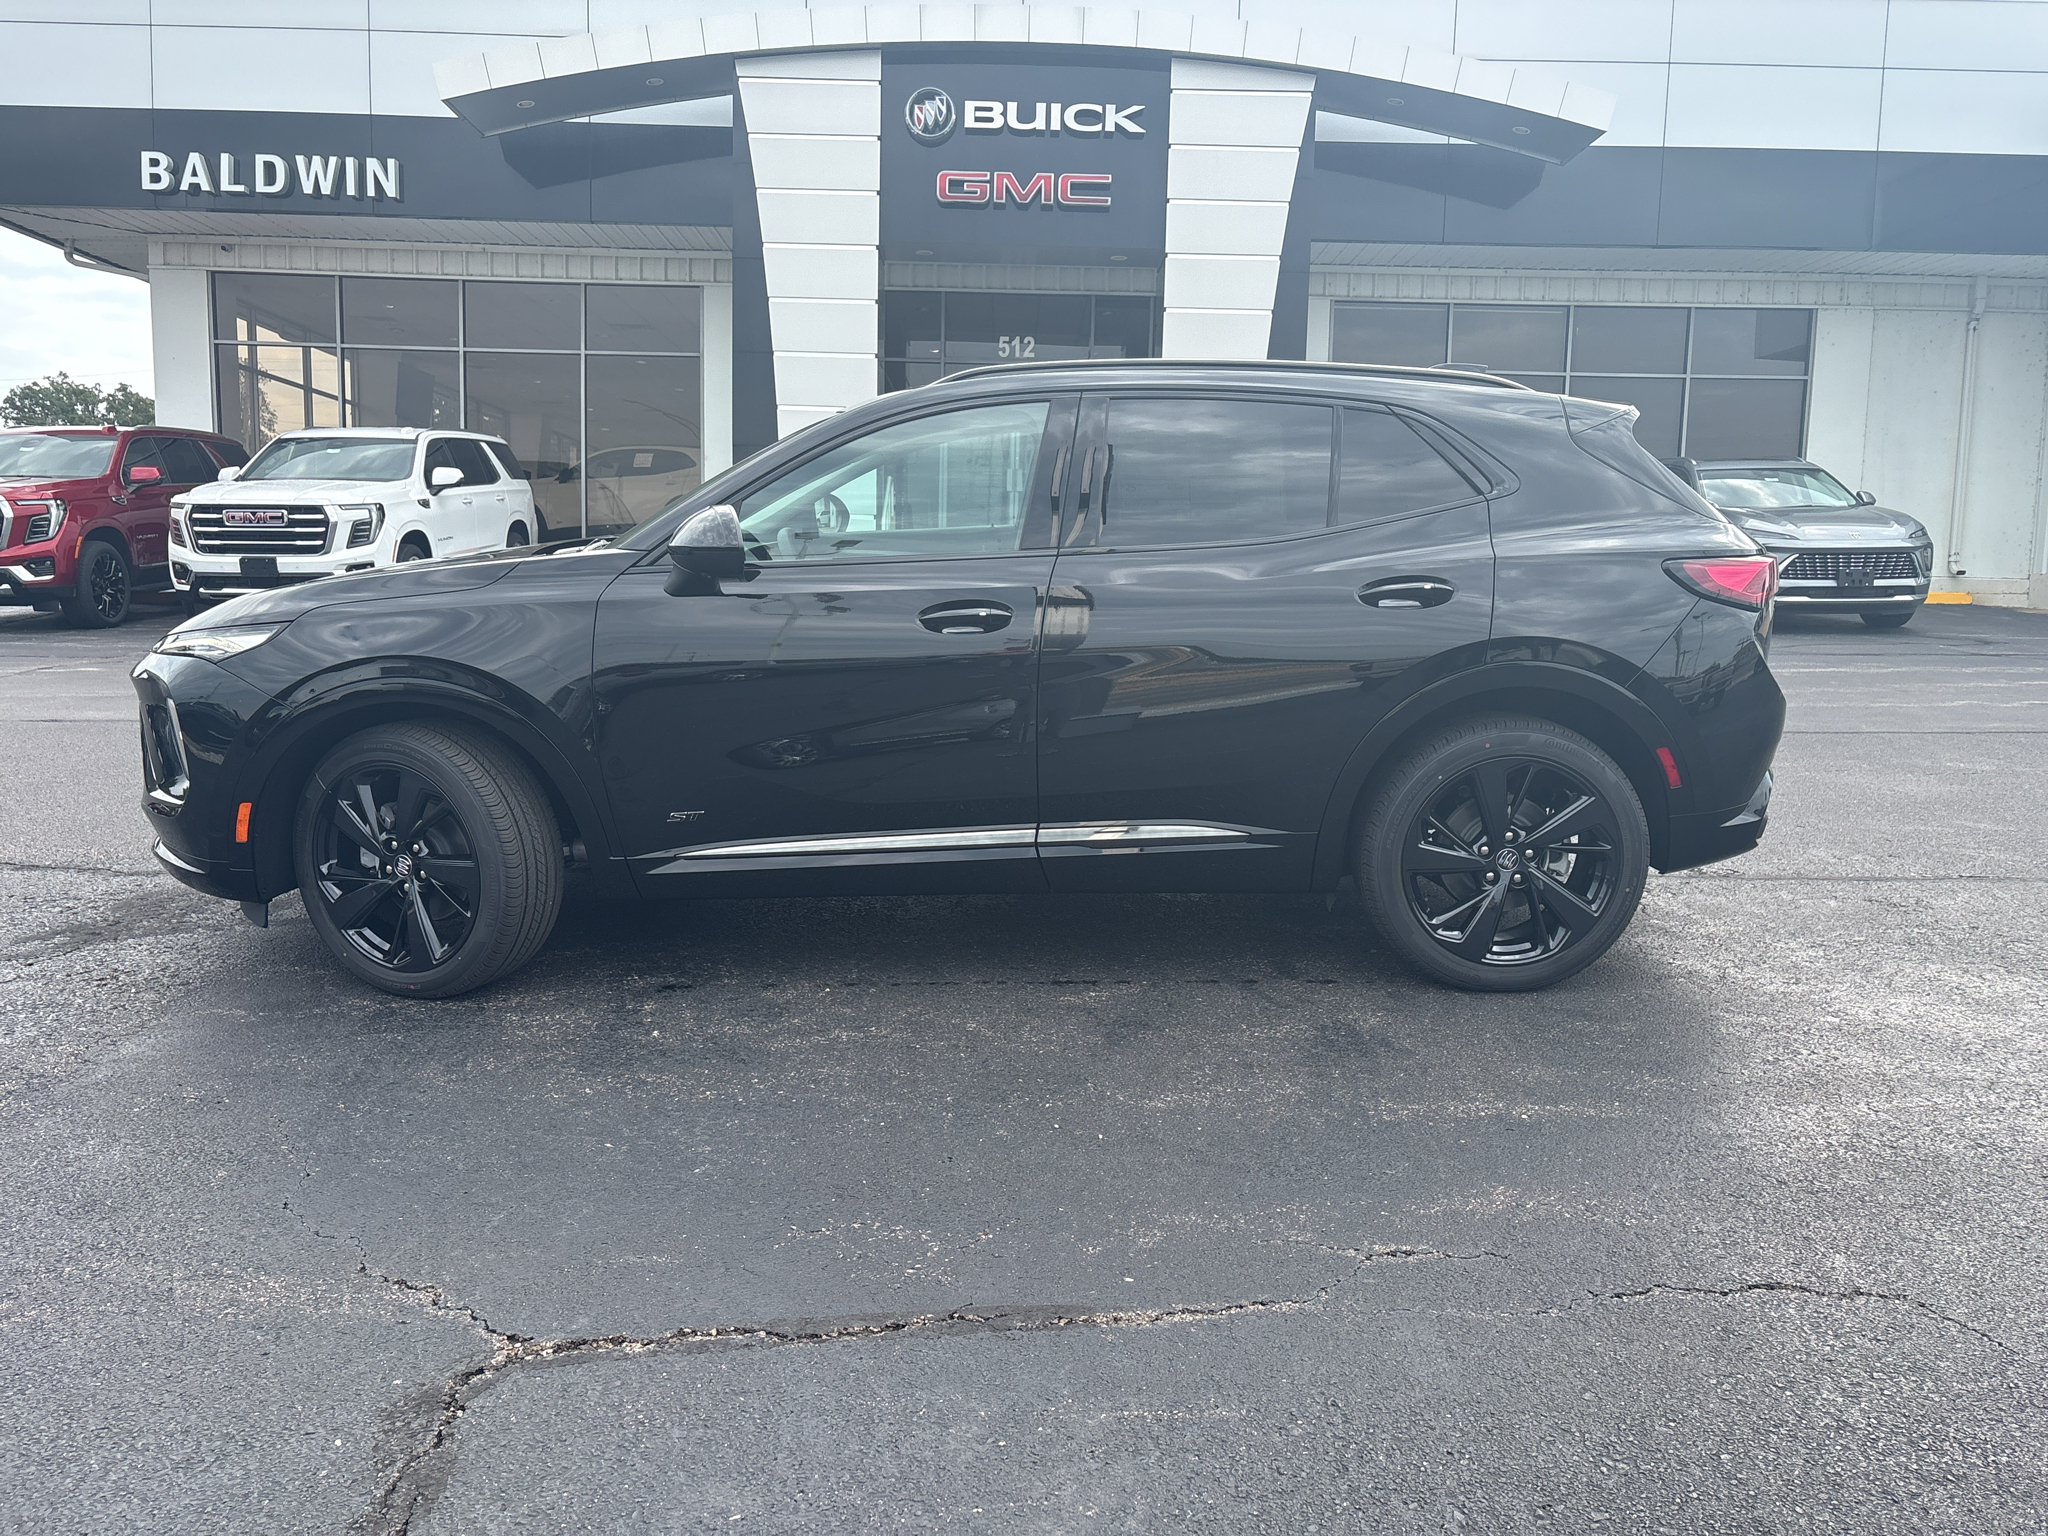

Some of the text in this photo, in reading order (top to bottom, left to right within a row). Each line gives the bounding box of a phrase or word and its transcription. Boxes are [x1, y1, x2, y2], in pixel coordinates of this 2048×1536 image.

[964, 100, 1146, 133] BUICK
[140, 150, 400, 199] BALDWIN
[937, 170, 1112, 206] GMC
[998, 336, 1035, 358] 512
[226, 511, 283, 524] GMC
[666, 810, 705, 822] ST
